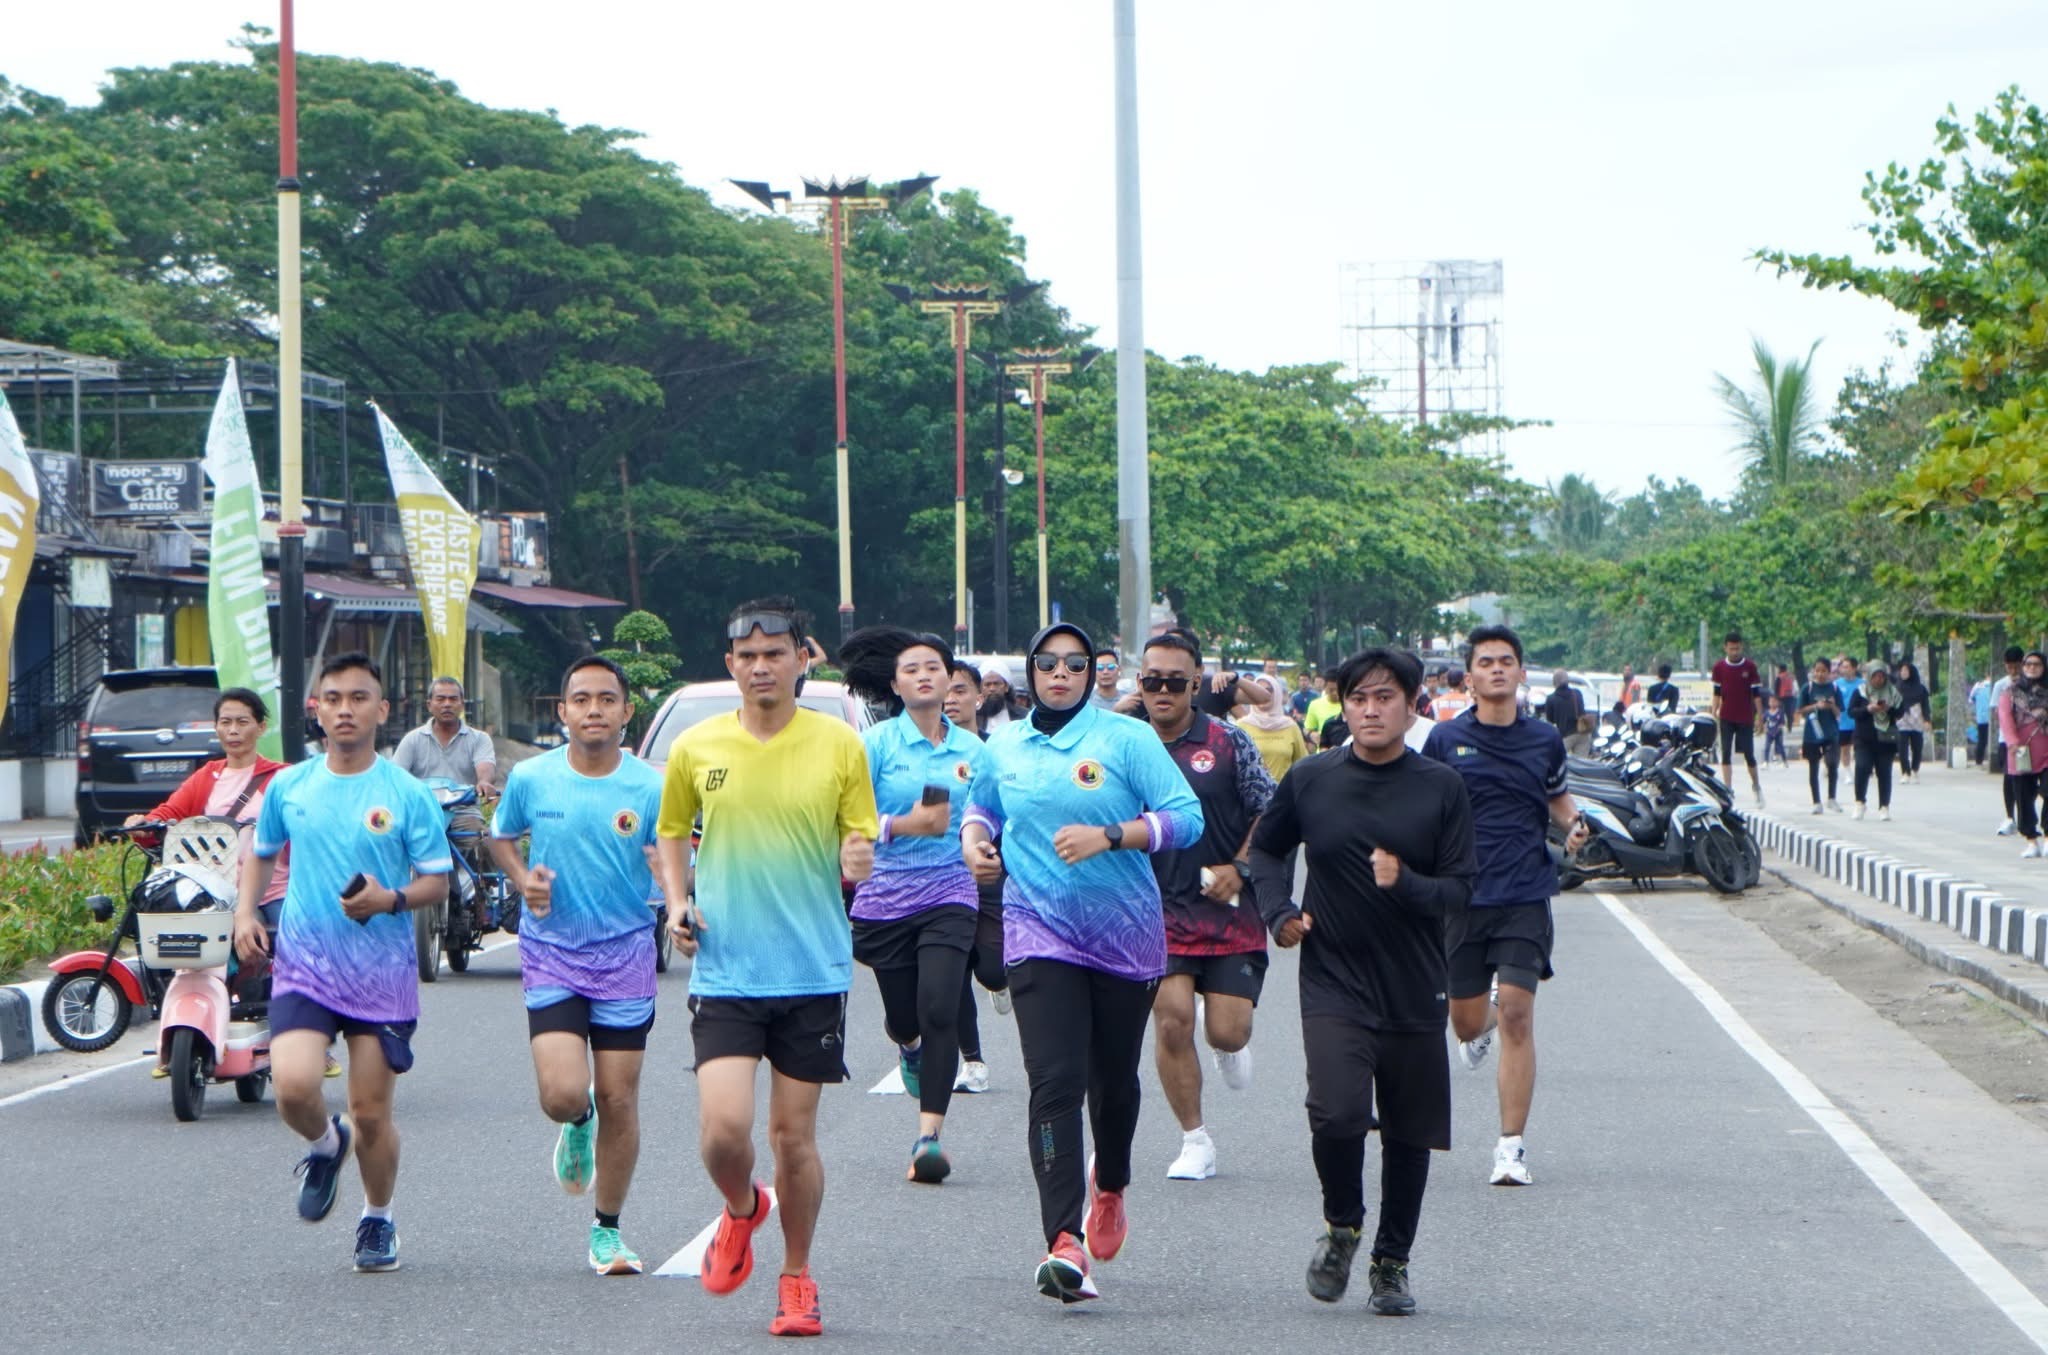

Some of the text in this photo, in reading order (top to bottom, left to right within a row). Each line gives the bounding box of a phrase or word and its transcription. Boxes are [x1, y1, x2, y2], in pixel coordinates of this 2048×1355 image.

[121, 480, 179, 502] Cafe
[419, 509, 447, 636] EXPERIENCE
[448, 513, 472, 604] TASTE OF
